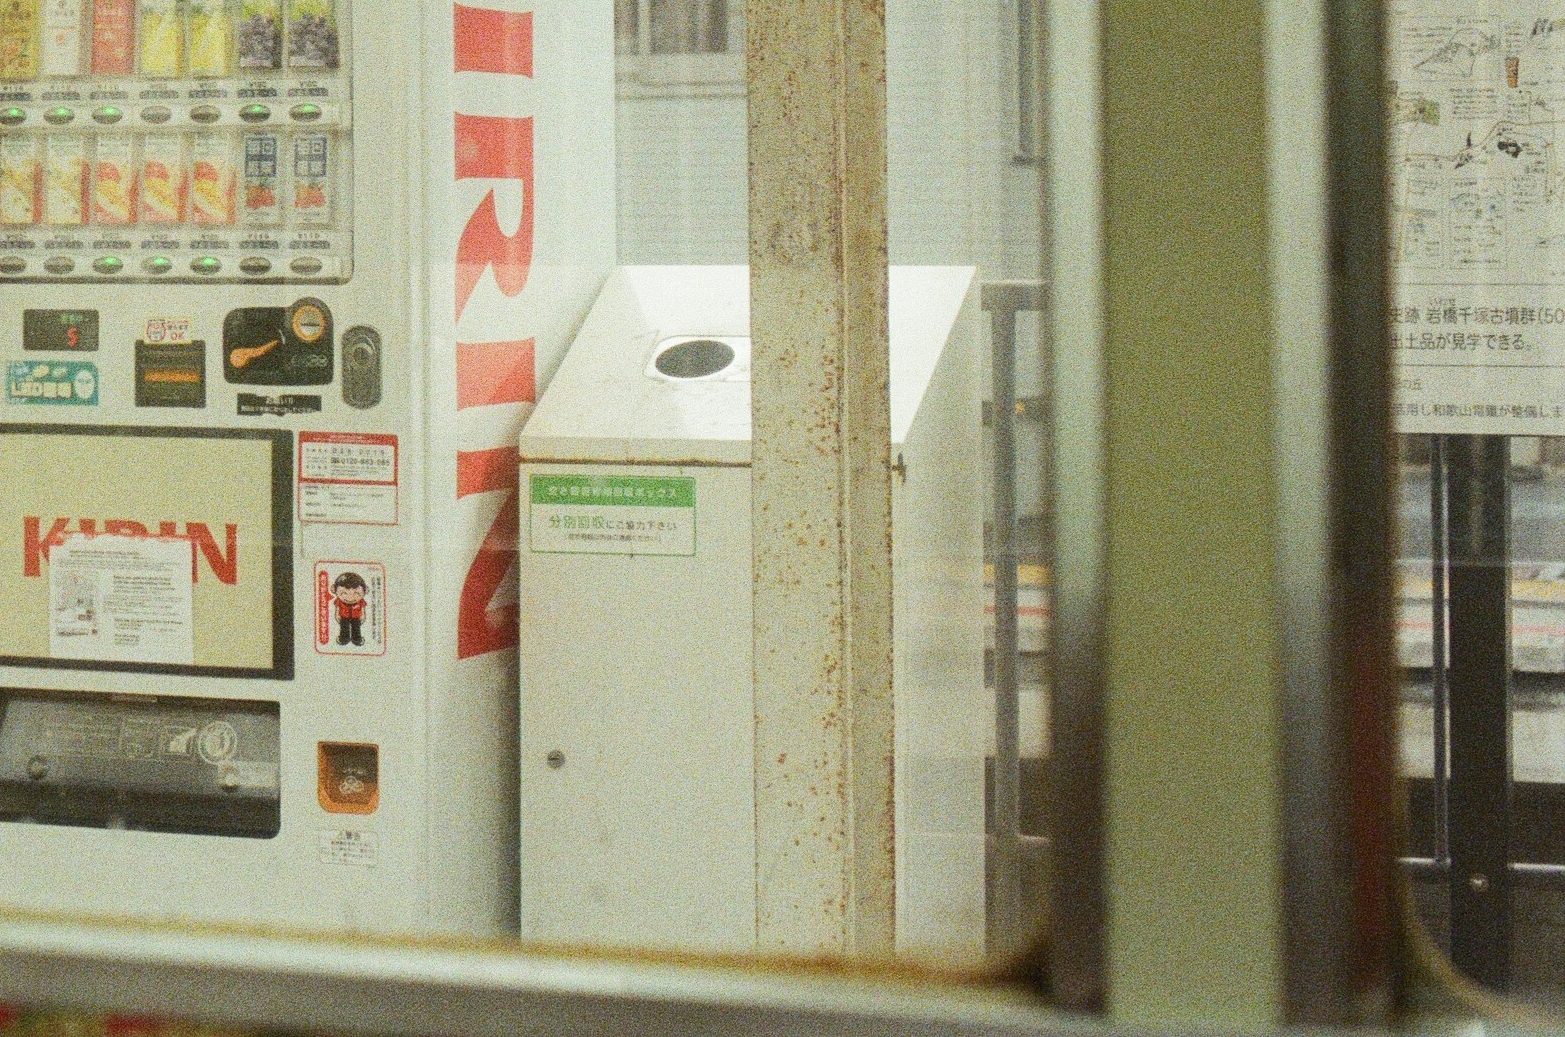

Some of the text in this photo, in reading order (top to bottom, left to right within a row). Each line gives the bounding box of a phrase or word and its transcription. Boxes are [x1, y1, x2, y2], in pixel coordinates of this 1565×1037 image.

[549, 515, 678, 531] 分別回収にご協力下さい
